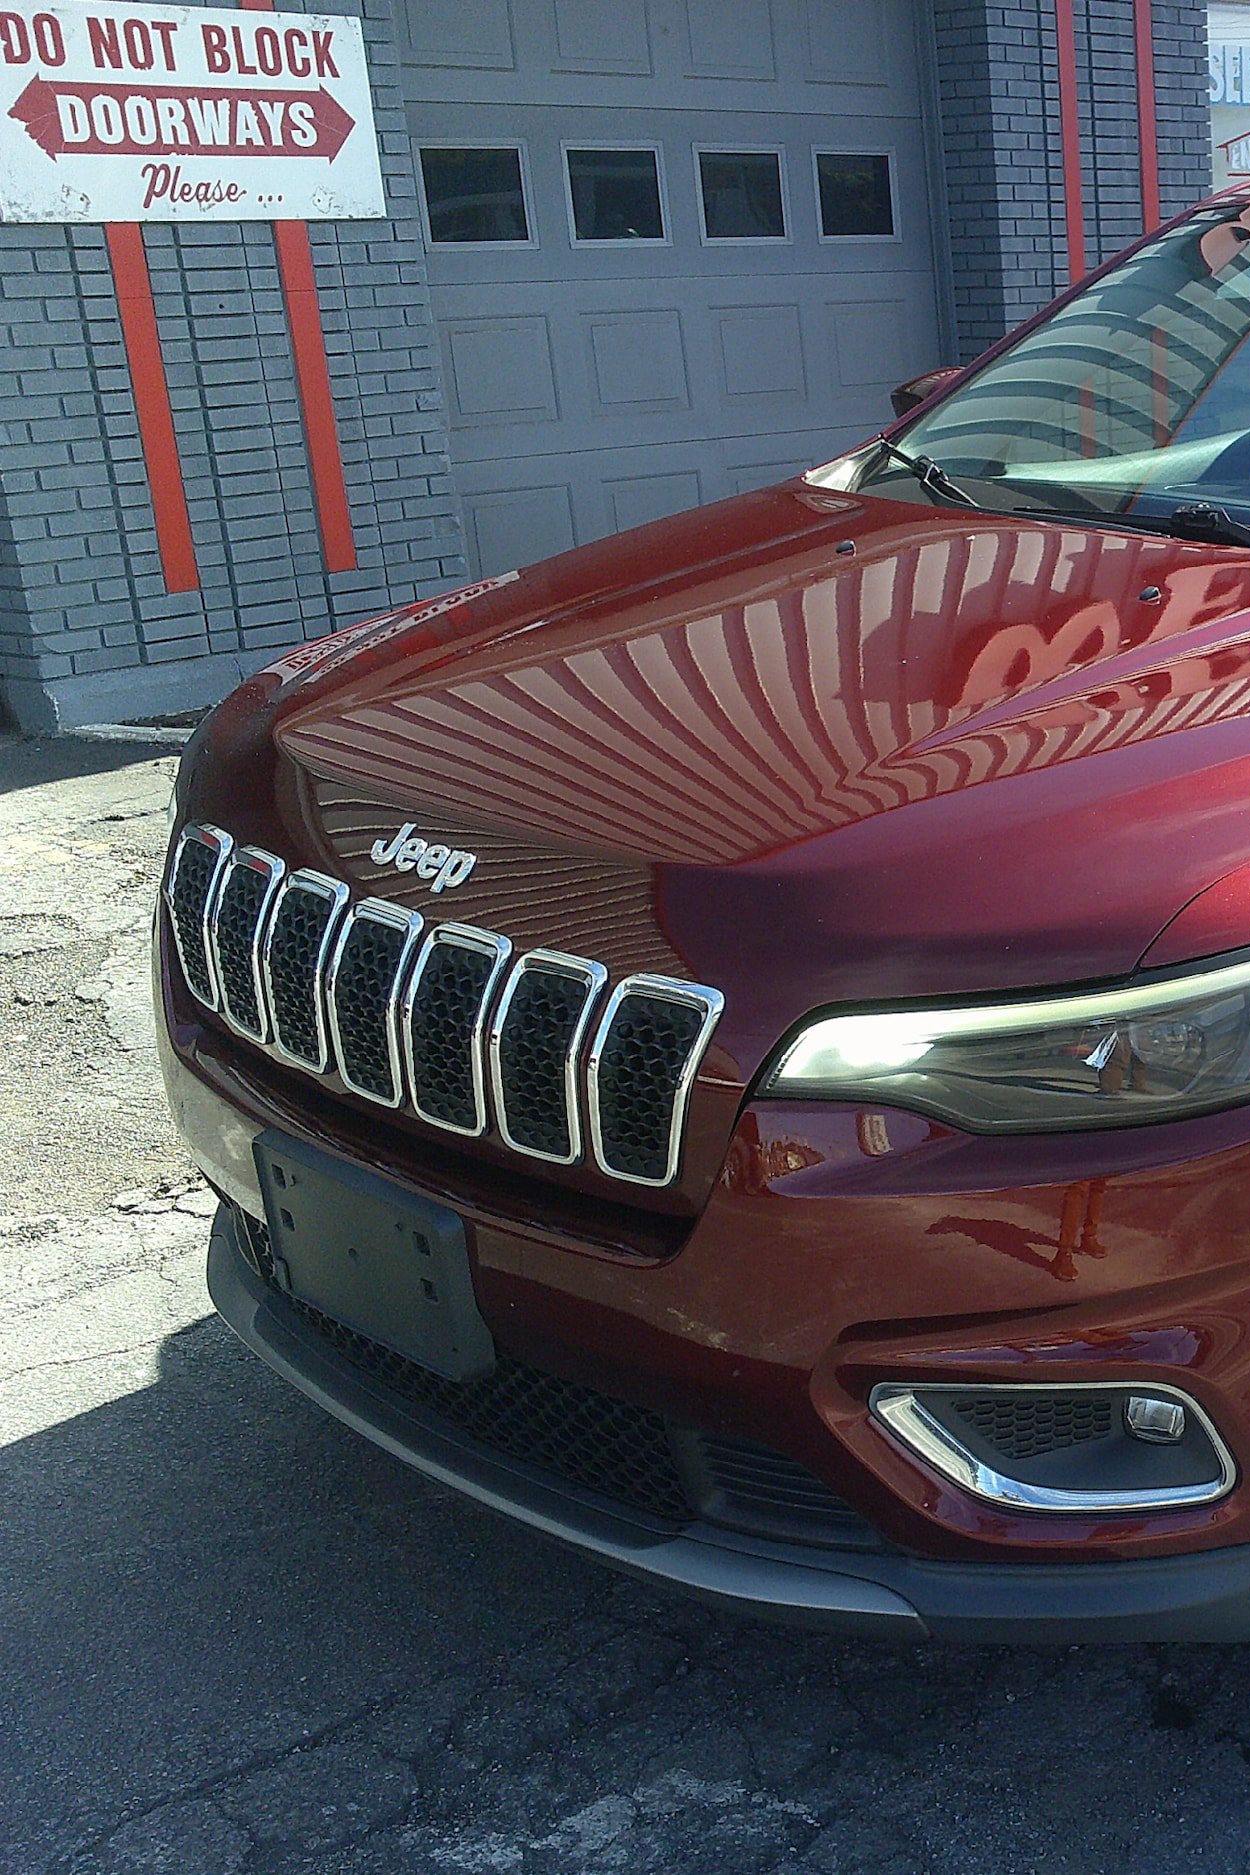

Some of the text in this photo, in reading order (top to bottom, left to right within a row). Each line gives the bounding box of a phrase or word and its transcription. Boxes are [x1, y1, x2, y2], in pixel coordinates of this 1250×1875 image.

[0, 11, 341, 78] DO NOT BLOCK
[55, 94, 319, 148] DOORWAYS
[140, 162, 247, 209] Please
[370, 822, 478, 893] Jeep
